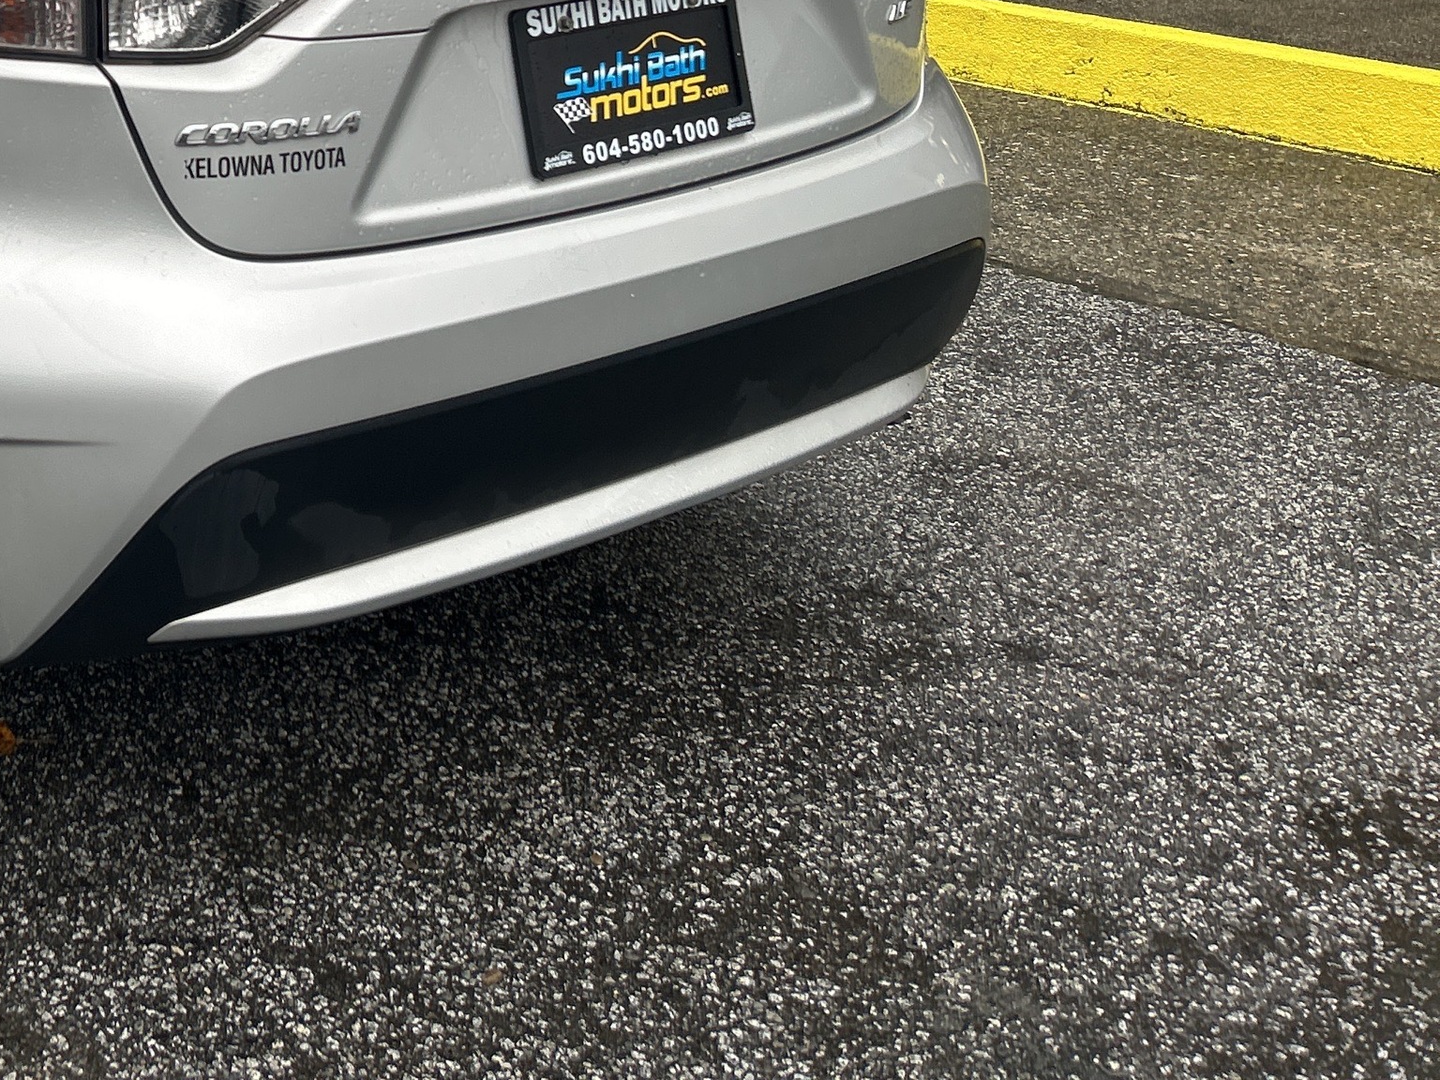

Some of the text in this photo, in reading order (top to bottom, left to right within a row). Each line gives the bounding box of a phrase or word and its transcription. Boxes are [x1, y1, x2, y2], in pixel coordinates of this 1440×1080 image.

[525, 0, 595, 38] SUKHI
[555, 44, 707, 100] Sukhi Bath
[174, 110, 362, 147] COROLLA
[581, 116, 721, 165] 604-580-1000
[184, 146, 346, 180] KELOWNA TOYOTA
